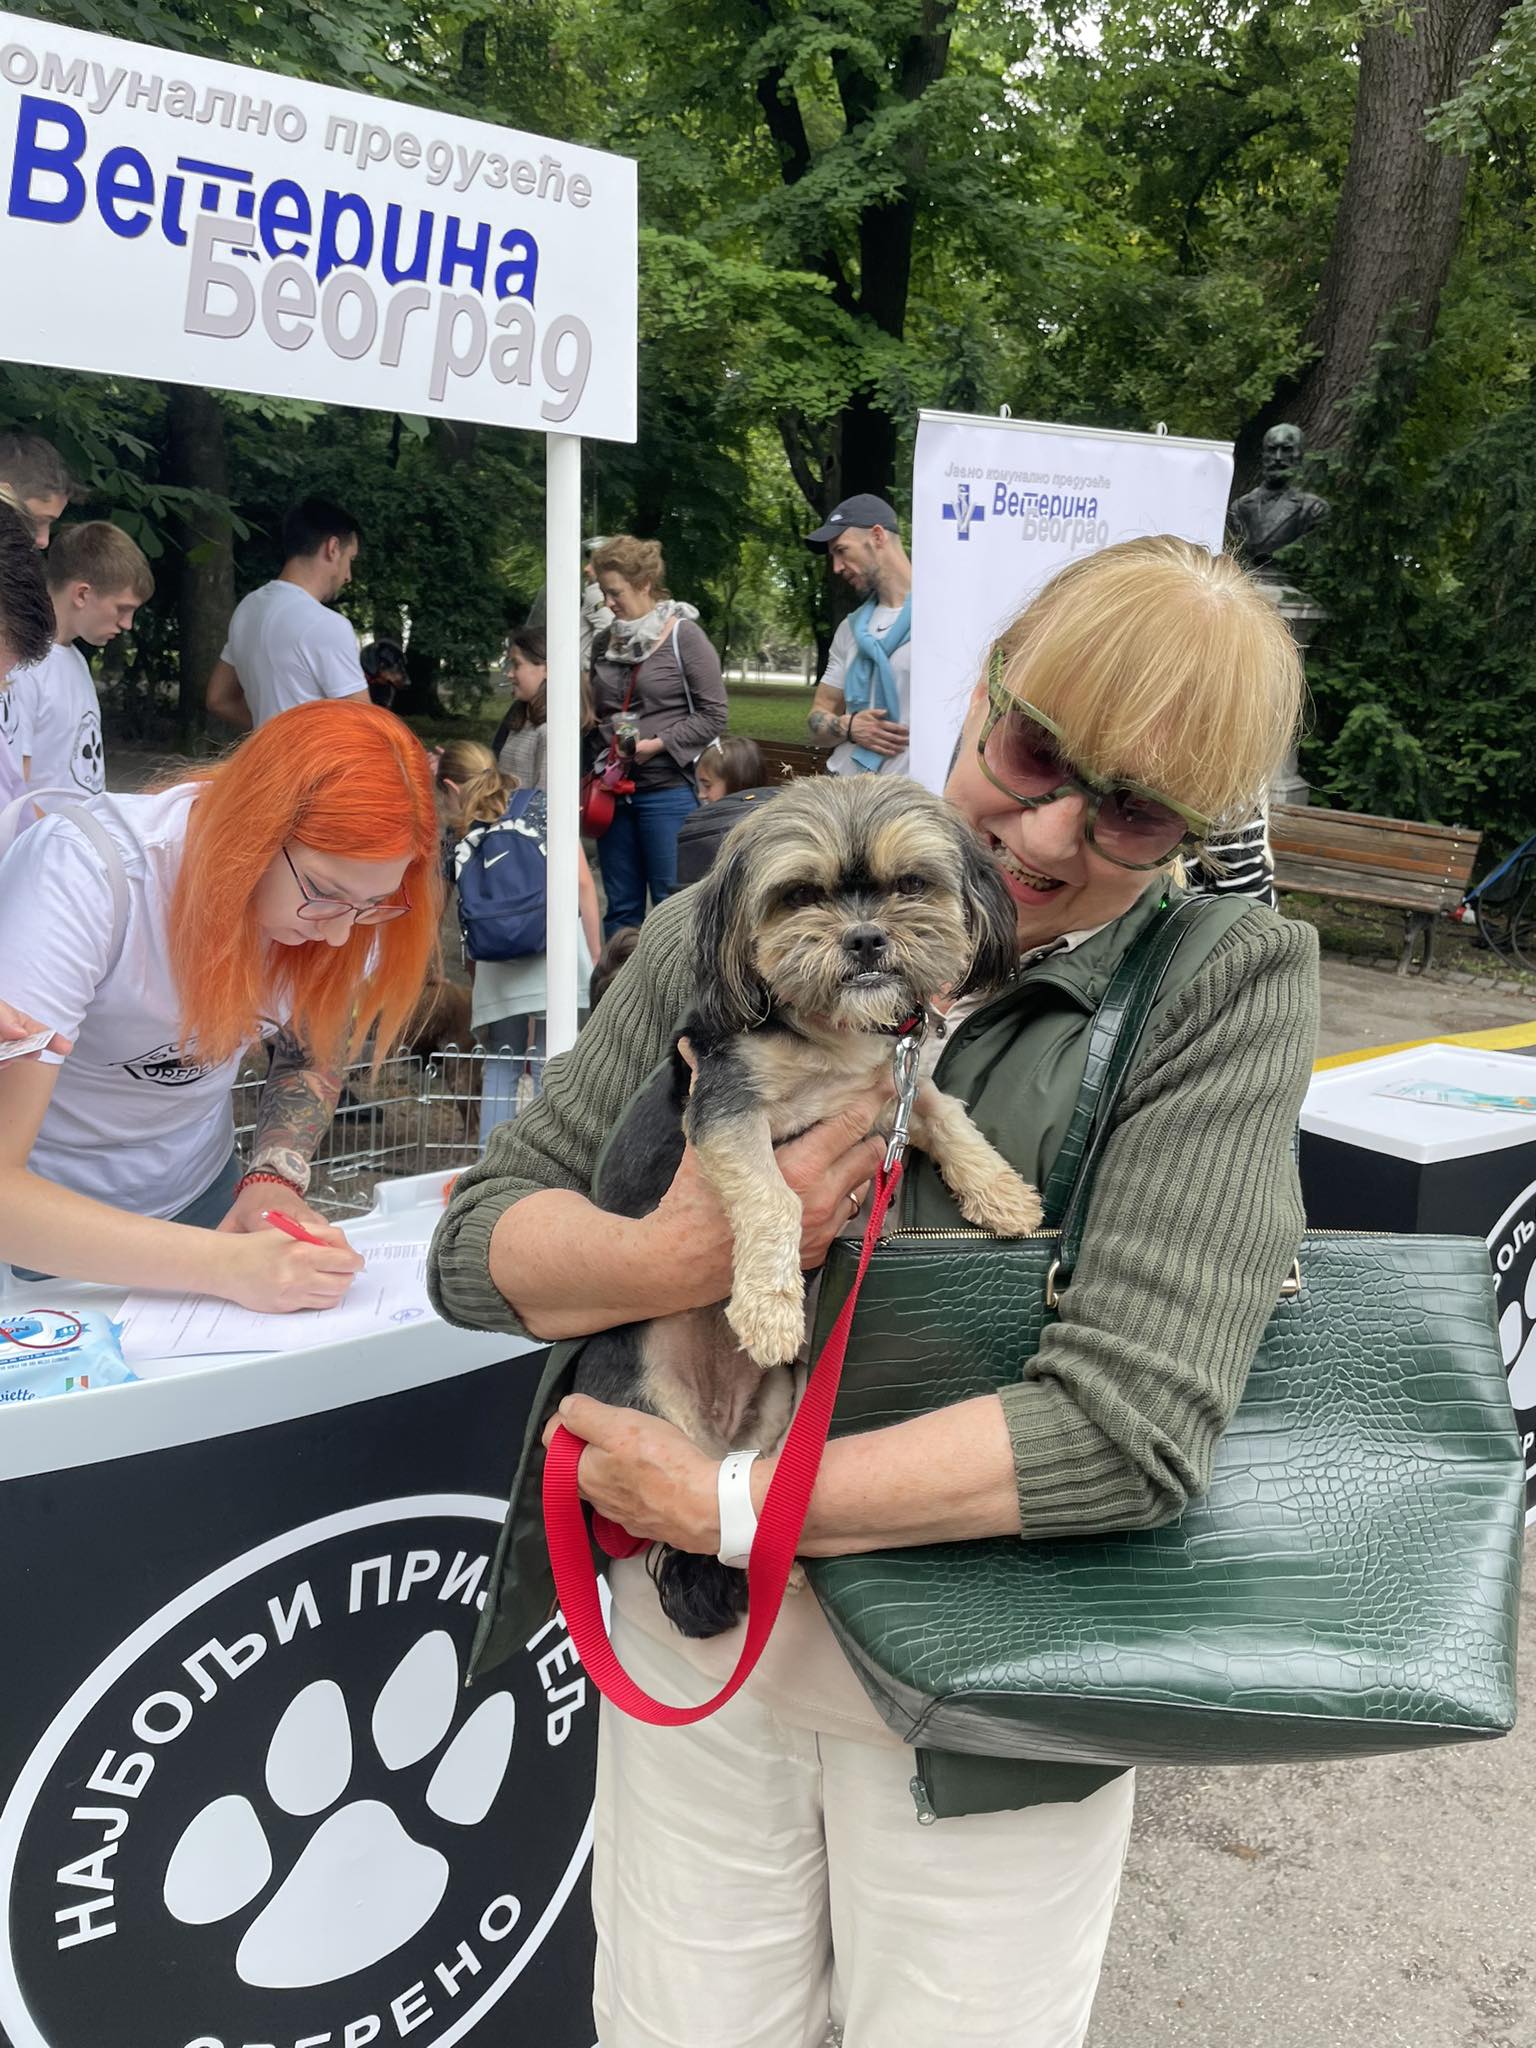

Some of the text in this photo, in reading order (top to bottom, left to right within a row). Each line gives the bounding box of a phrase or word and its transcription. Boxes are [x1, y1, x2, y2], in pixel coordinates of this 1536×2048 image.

[2, 43, 593, 208] омунално предузеће
[8, 94, 540, 307] Ветерина
[184, 214, 593, 422] Београд
[992, 482, 1098, 521] Ветерина
[55, 1580, 322, 1950] НАЈБОЉИ
